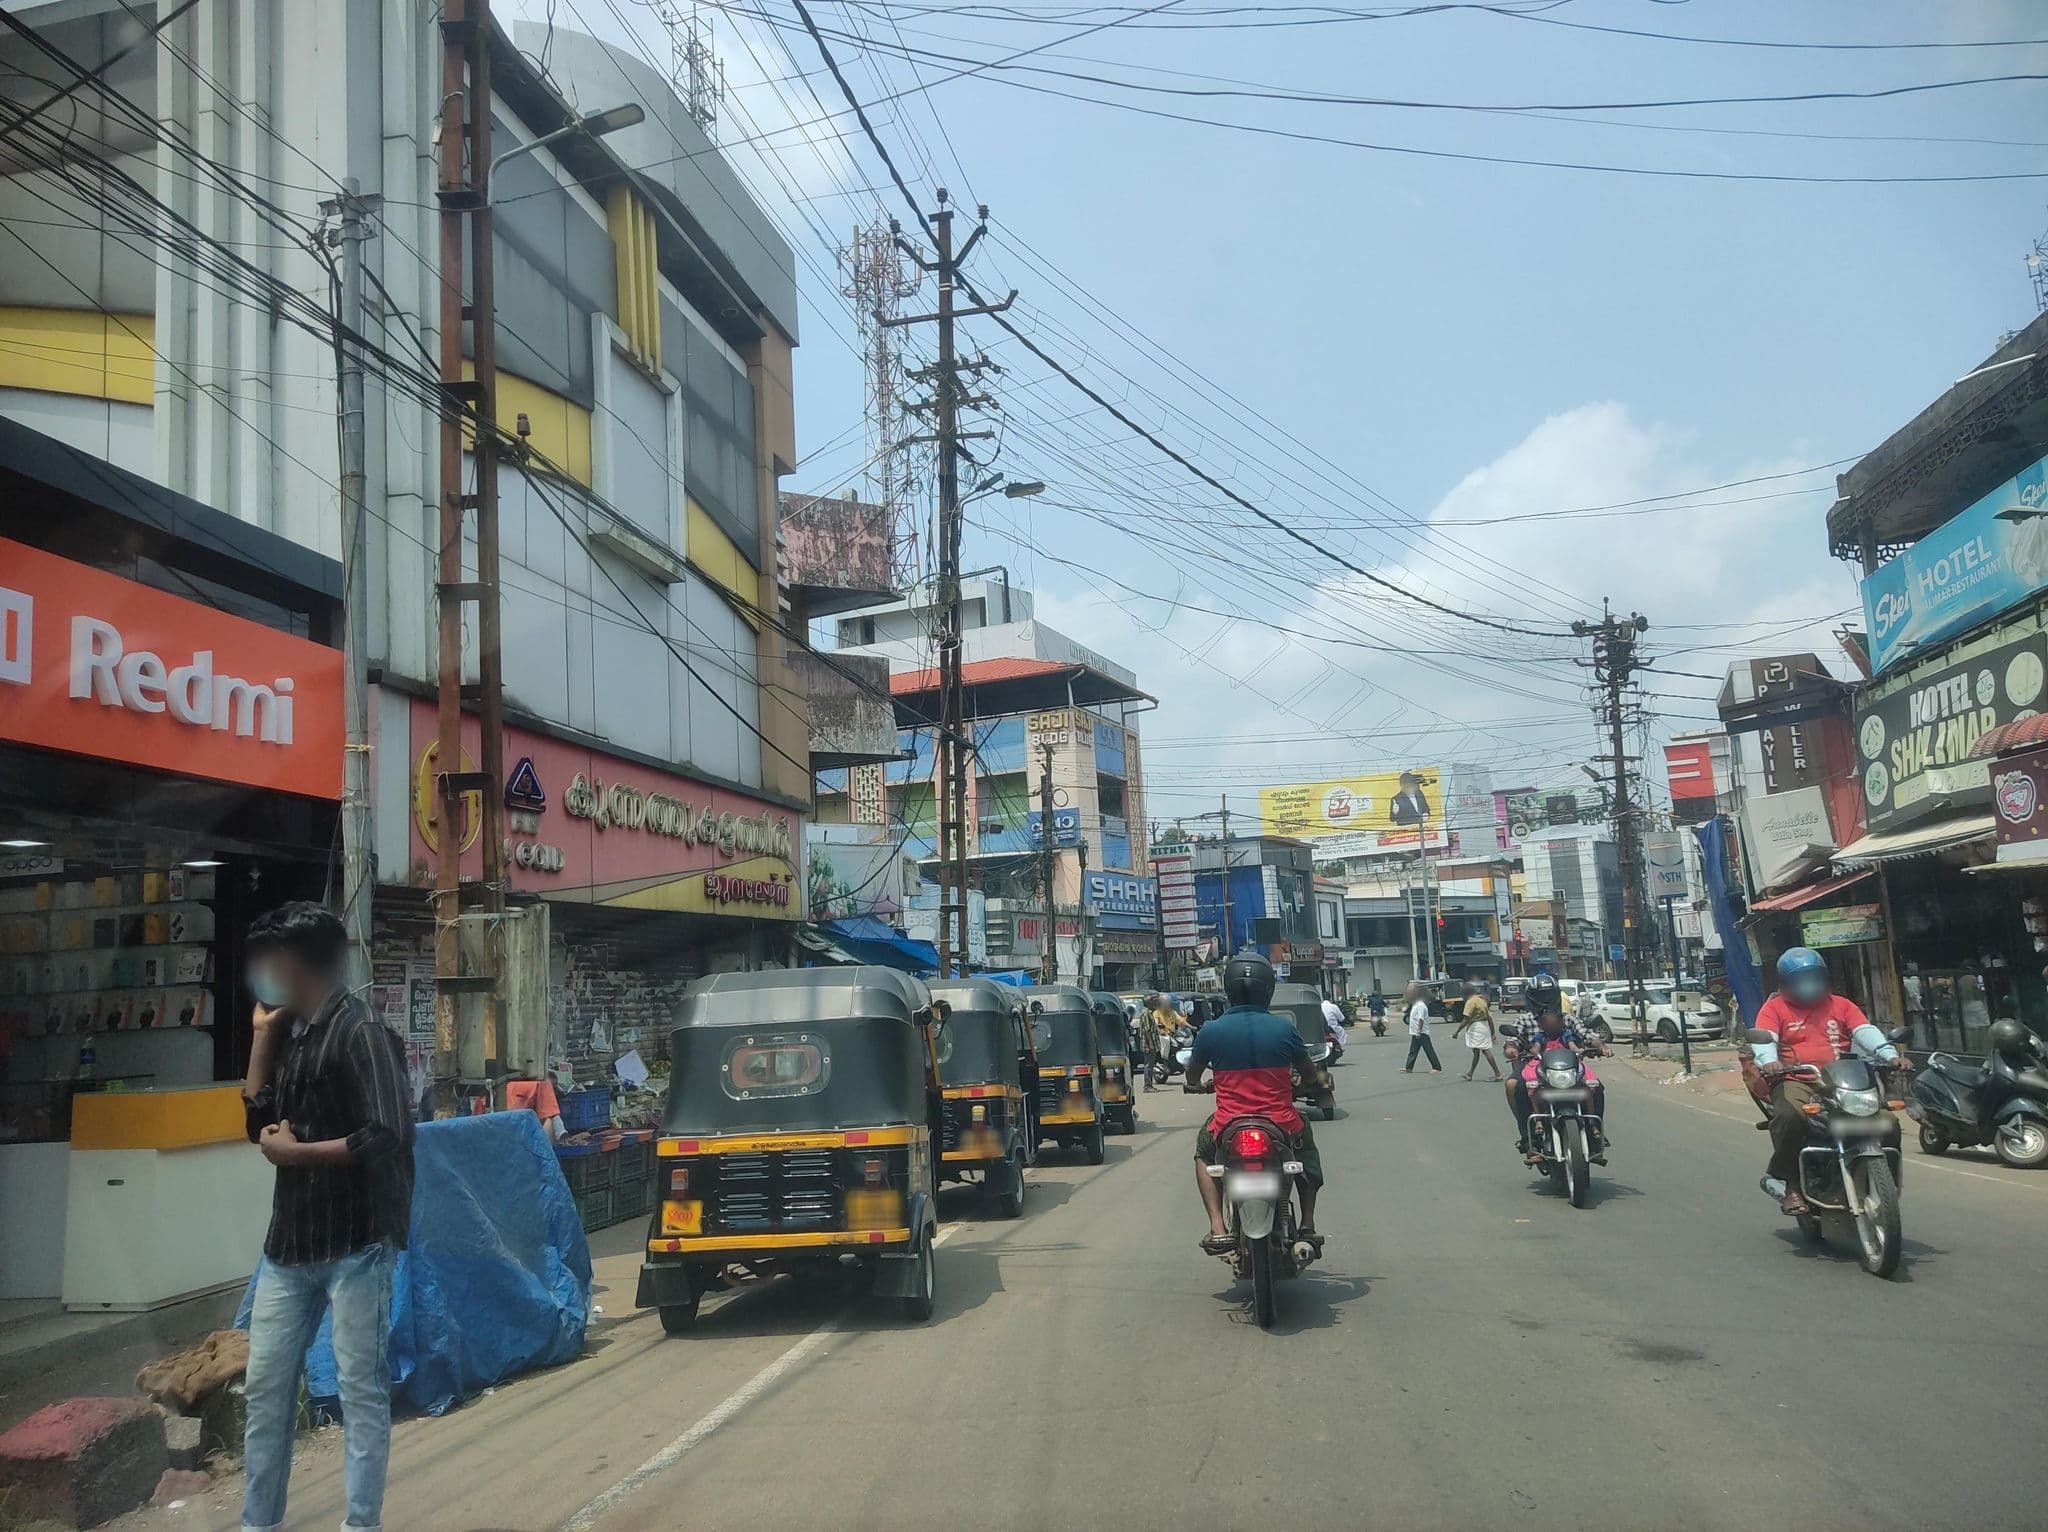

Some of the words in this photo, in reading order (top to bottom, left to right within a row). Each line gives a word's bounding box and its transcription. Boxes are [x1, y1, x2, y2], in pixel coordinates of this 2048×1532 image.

[1917, 535, 1993, 595] HOTEL
[69, 615, 294, 745] Redmi
[1909, 673, 1973, 729] HOTEL
[1028, 711, 1069, 732] SAJI
[1032, 731, 1068, 747] BLDG
[1758, 685, 1778, 787] PAYIL
[1891, 707, 1996, 782] SHALIMAR
[1092, 876, 1156, 903] SHAH
